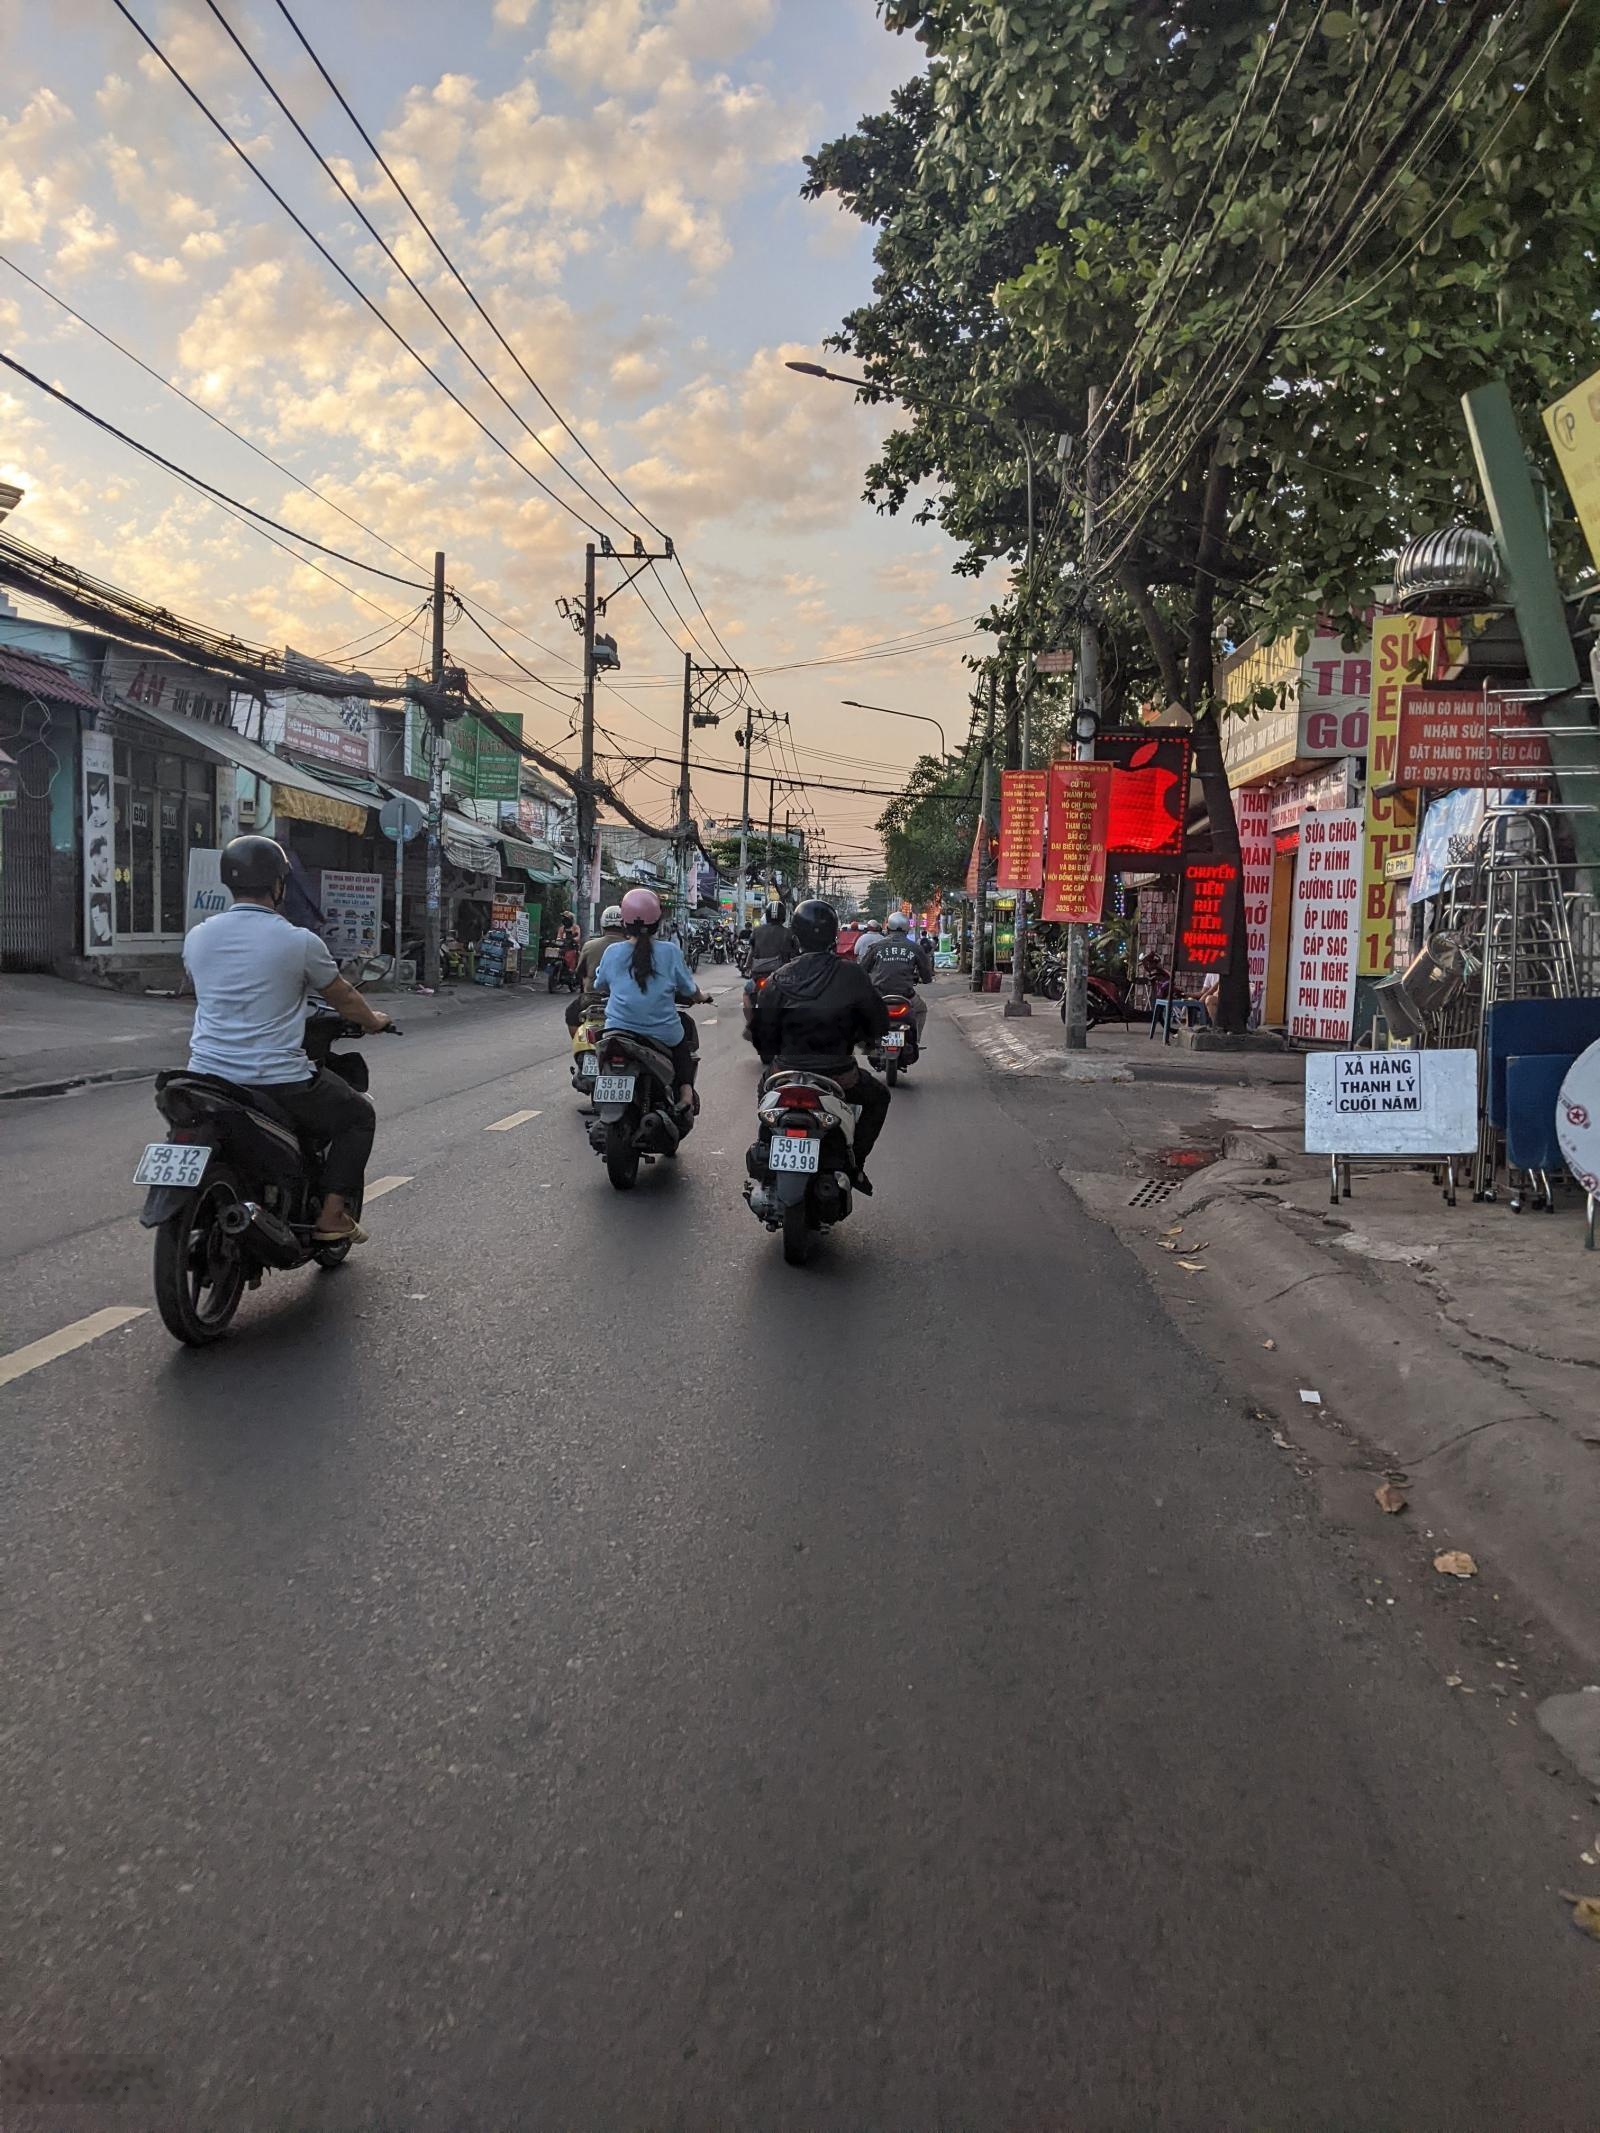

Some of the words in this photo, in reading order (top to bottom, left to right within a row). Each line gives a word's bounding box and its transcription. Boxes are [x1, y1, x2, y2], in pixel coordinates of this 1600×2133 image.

[1423, 721, 1457, 741] NHẬN
[1433, 742, 1461, 760] HÀNG
[1424, 766, 1449, 781] 0974
[1452, 767, 1471, 781] 973
[1240, 818, 1268, 838] PIN
[1305, 818, 1325, 843] SỬA
[1328, 817, 1357, 842] CHỮA
[1309, 849, 1321, 871] ÉP
[1324, 846, 1349, 871] KÍNH
[1299, 875, 1333, 900] CƯỜNG
[1336, 878, 1357, 903] LỰC
[1304, 904, 1318, 930] ỐP
[1321, 908, 1348, 930] LƯNG
[1303, 933, 1324, 956] CÁP
[1326, 936, 1347, 960] SẠC
[1300, 962, 1317, 981] TAI
[1321, 962, 1349, 983] NGHE
[1298, 986, 1319, 1012] PHỤ
[1323, 986, 1347, 1014] KIỆN
[1292, 1013, 1316, 1037] ĐIỆN
[1344, 1056, 1364, 1076] XẢ
[1370, 1055, 1412, 1075] HÀNG
[601, 1079, 628, 1089] 59-B1
[1340, 1080, 1391, 1093] THANH
[1397, 1076, 1416, 1092] LÝ
[1339, 1094, 1376, 1111] CUỐI
[1382, 1096, 1418, 1110] NĂM
[151, 1148, 200, 1165] 59-X2
[778, 1139, 811, 1154] 59-U1
[773, 1154, 816, 1170] 343.98
